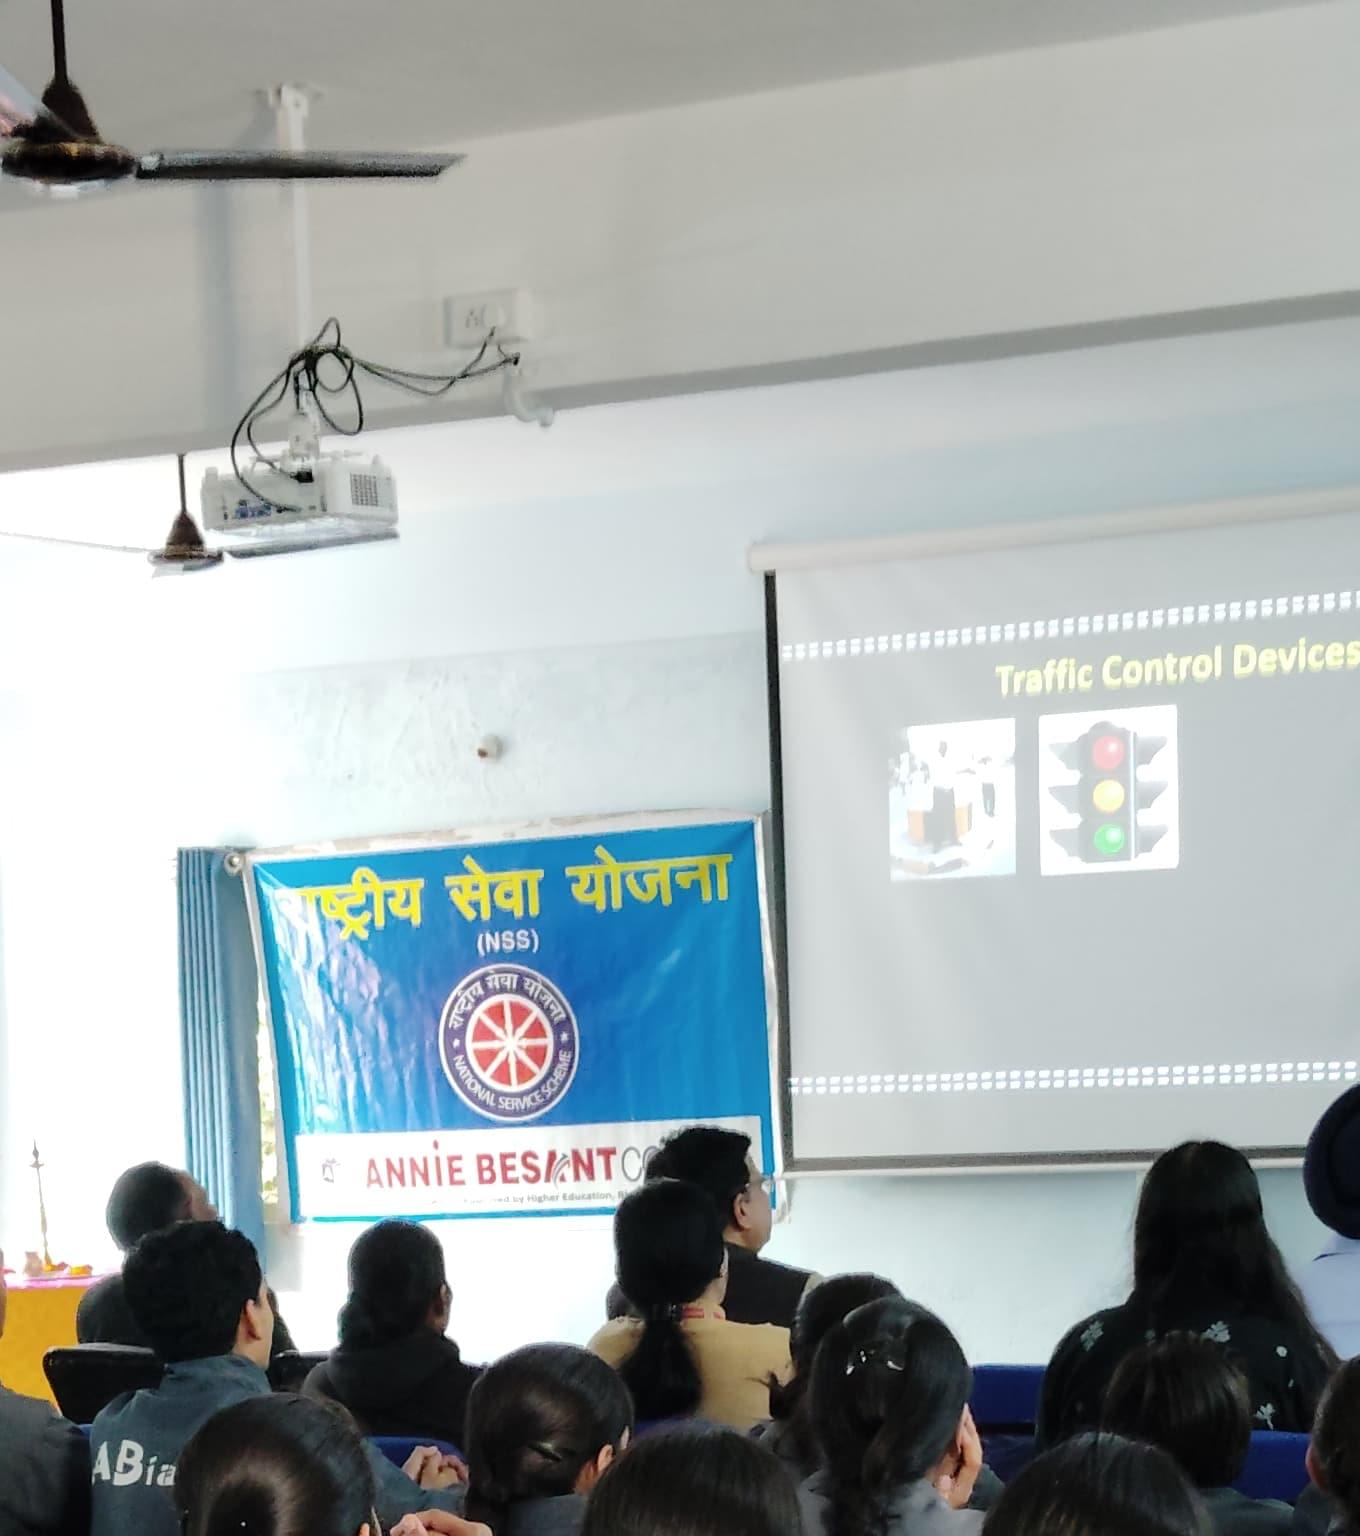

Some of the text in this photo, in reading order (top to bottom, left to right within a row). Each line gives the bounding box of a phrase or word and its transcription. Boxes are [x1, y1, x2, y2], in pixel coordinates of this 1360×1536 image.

[995, 658, 1093, 698] Traffic
[1102, 645, 1222, 689] Control
[444, 854, 545, 921] सेवा
[564, 844, 734, 913] योजना
[476, 928, 540, 957] (NSS)
[453, 1049, 572, 1112] NATIONAL SERVICE SCHEME
[476, 1146, 617, 1189] BESANT
[92, 1439, 177, 1487] ABia
